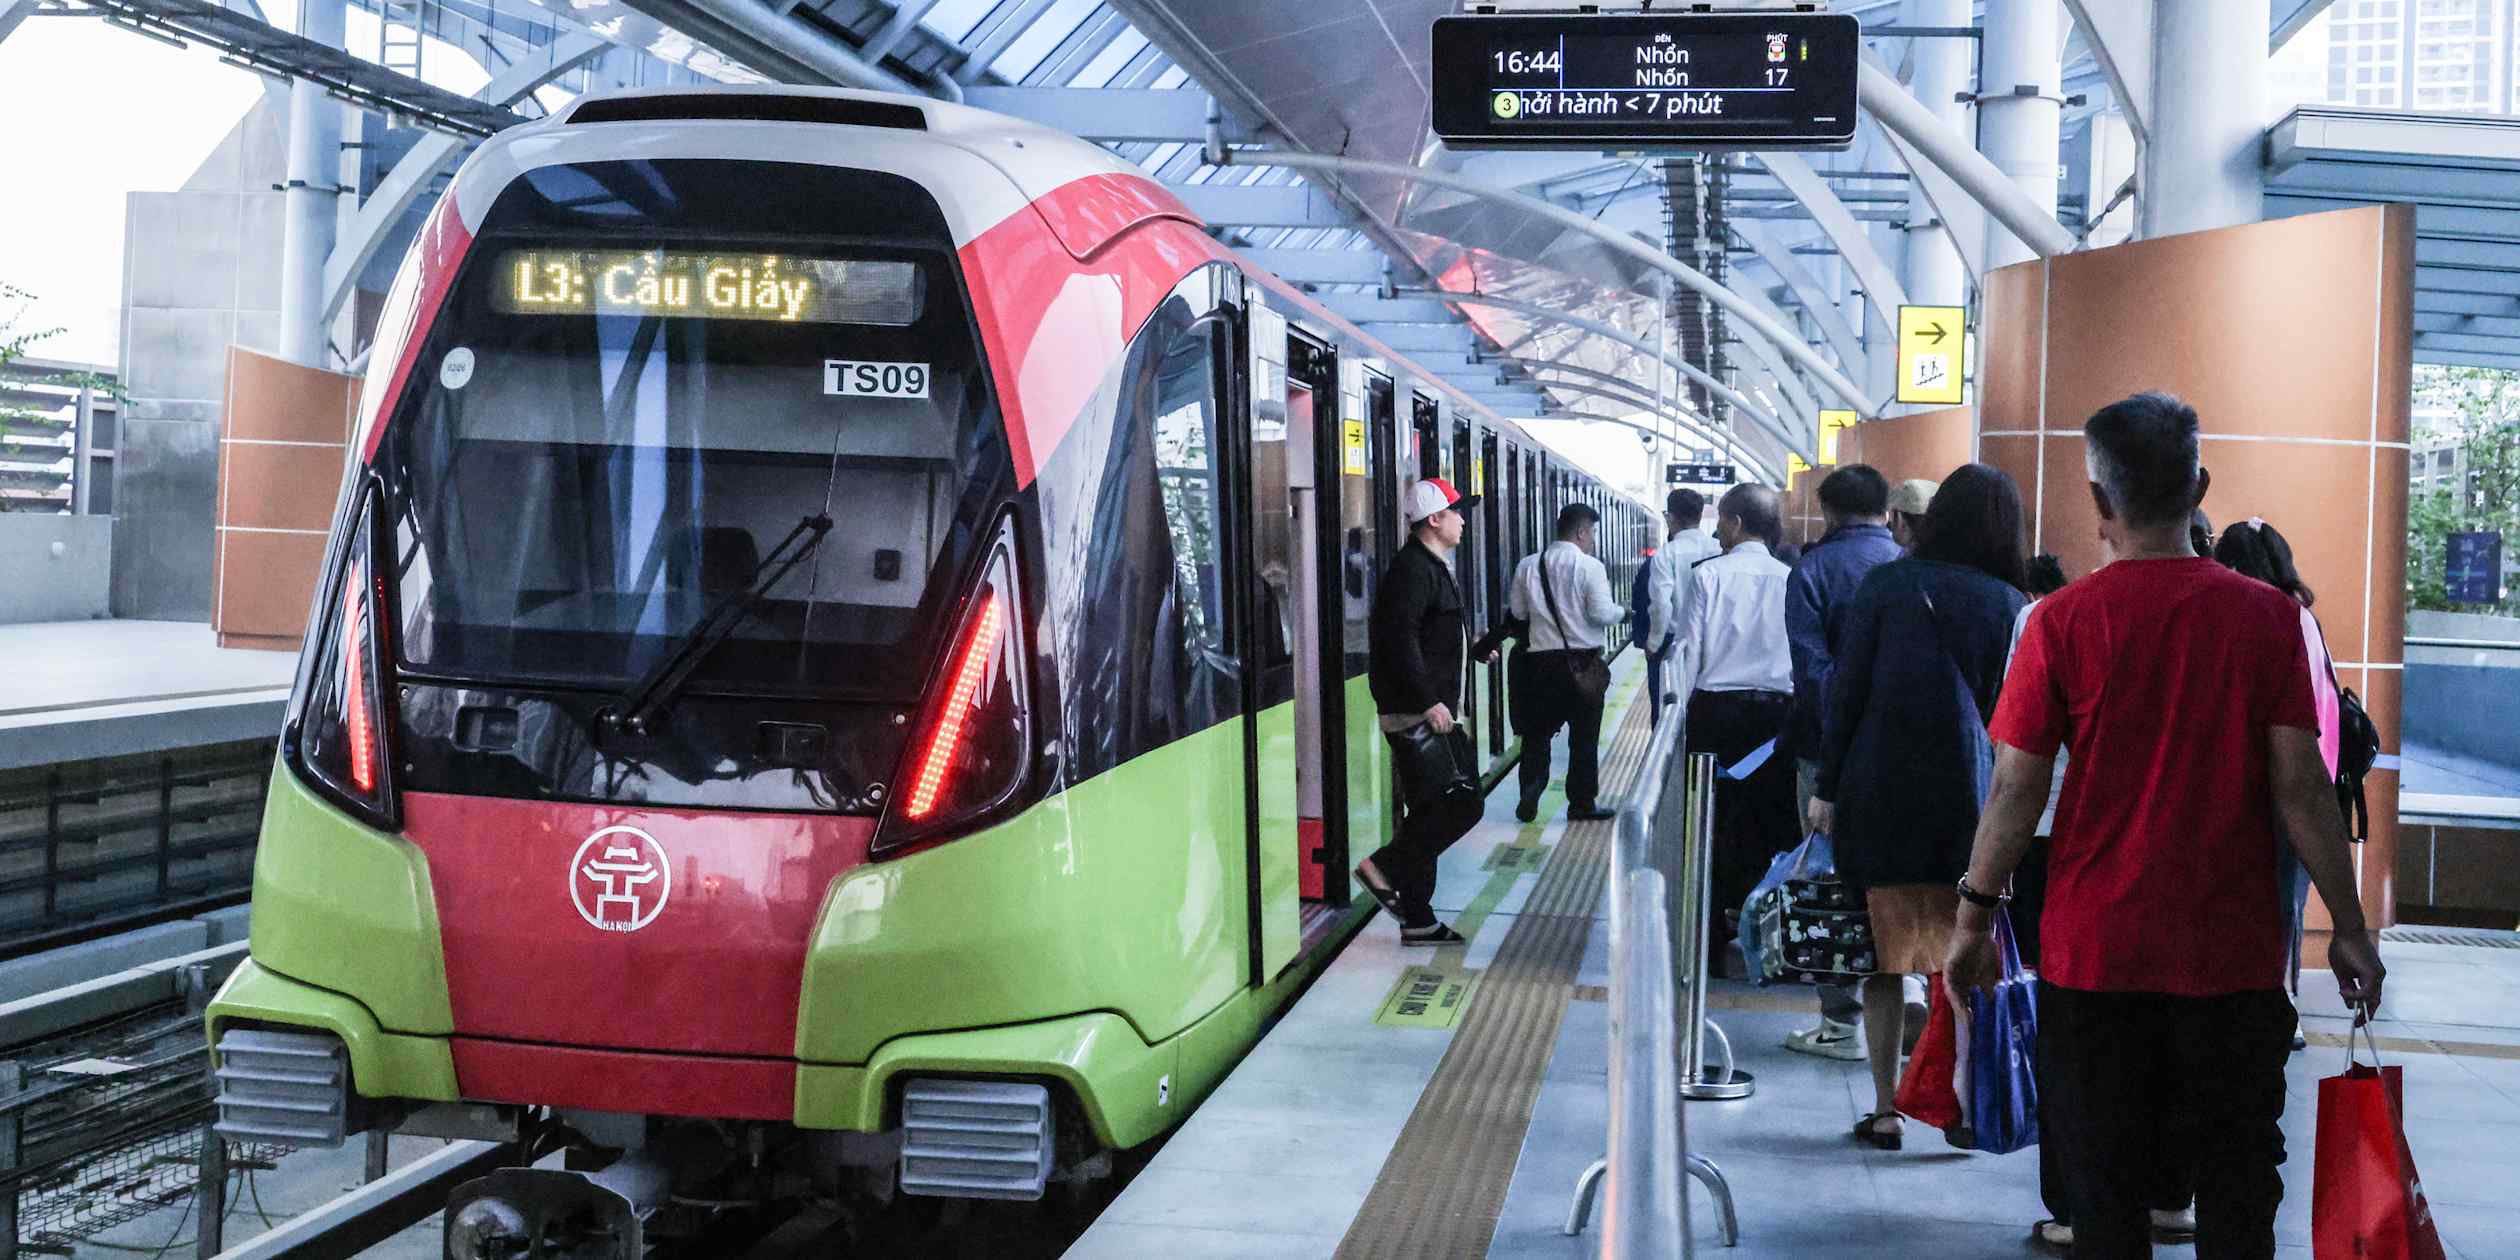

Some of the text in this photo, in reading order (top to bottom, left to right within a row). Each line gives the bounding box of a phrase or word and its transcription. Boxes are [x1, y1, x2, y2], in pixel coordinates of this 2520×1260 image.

[1494, 50, 1561, 73] 16:44
[1636, 43, 1689, 64] Nhổn
[1765, 68, 1788, 86] 17
[1503, 98, 1511, 111] 3
[1559, 92, 1618, 114] hành
[1646, 93, 1661, 114] 7
[1666, 92, 1723, 120] phút
[519, 261, 583, 304] L3:
[829, 363, 925, 394] TS09
